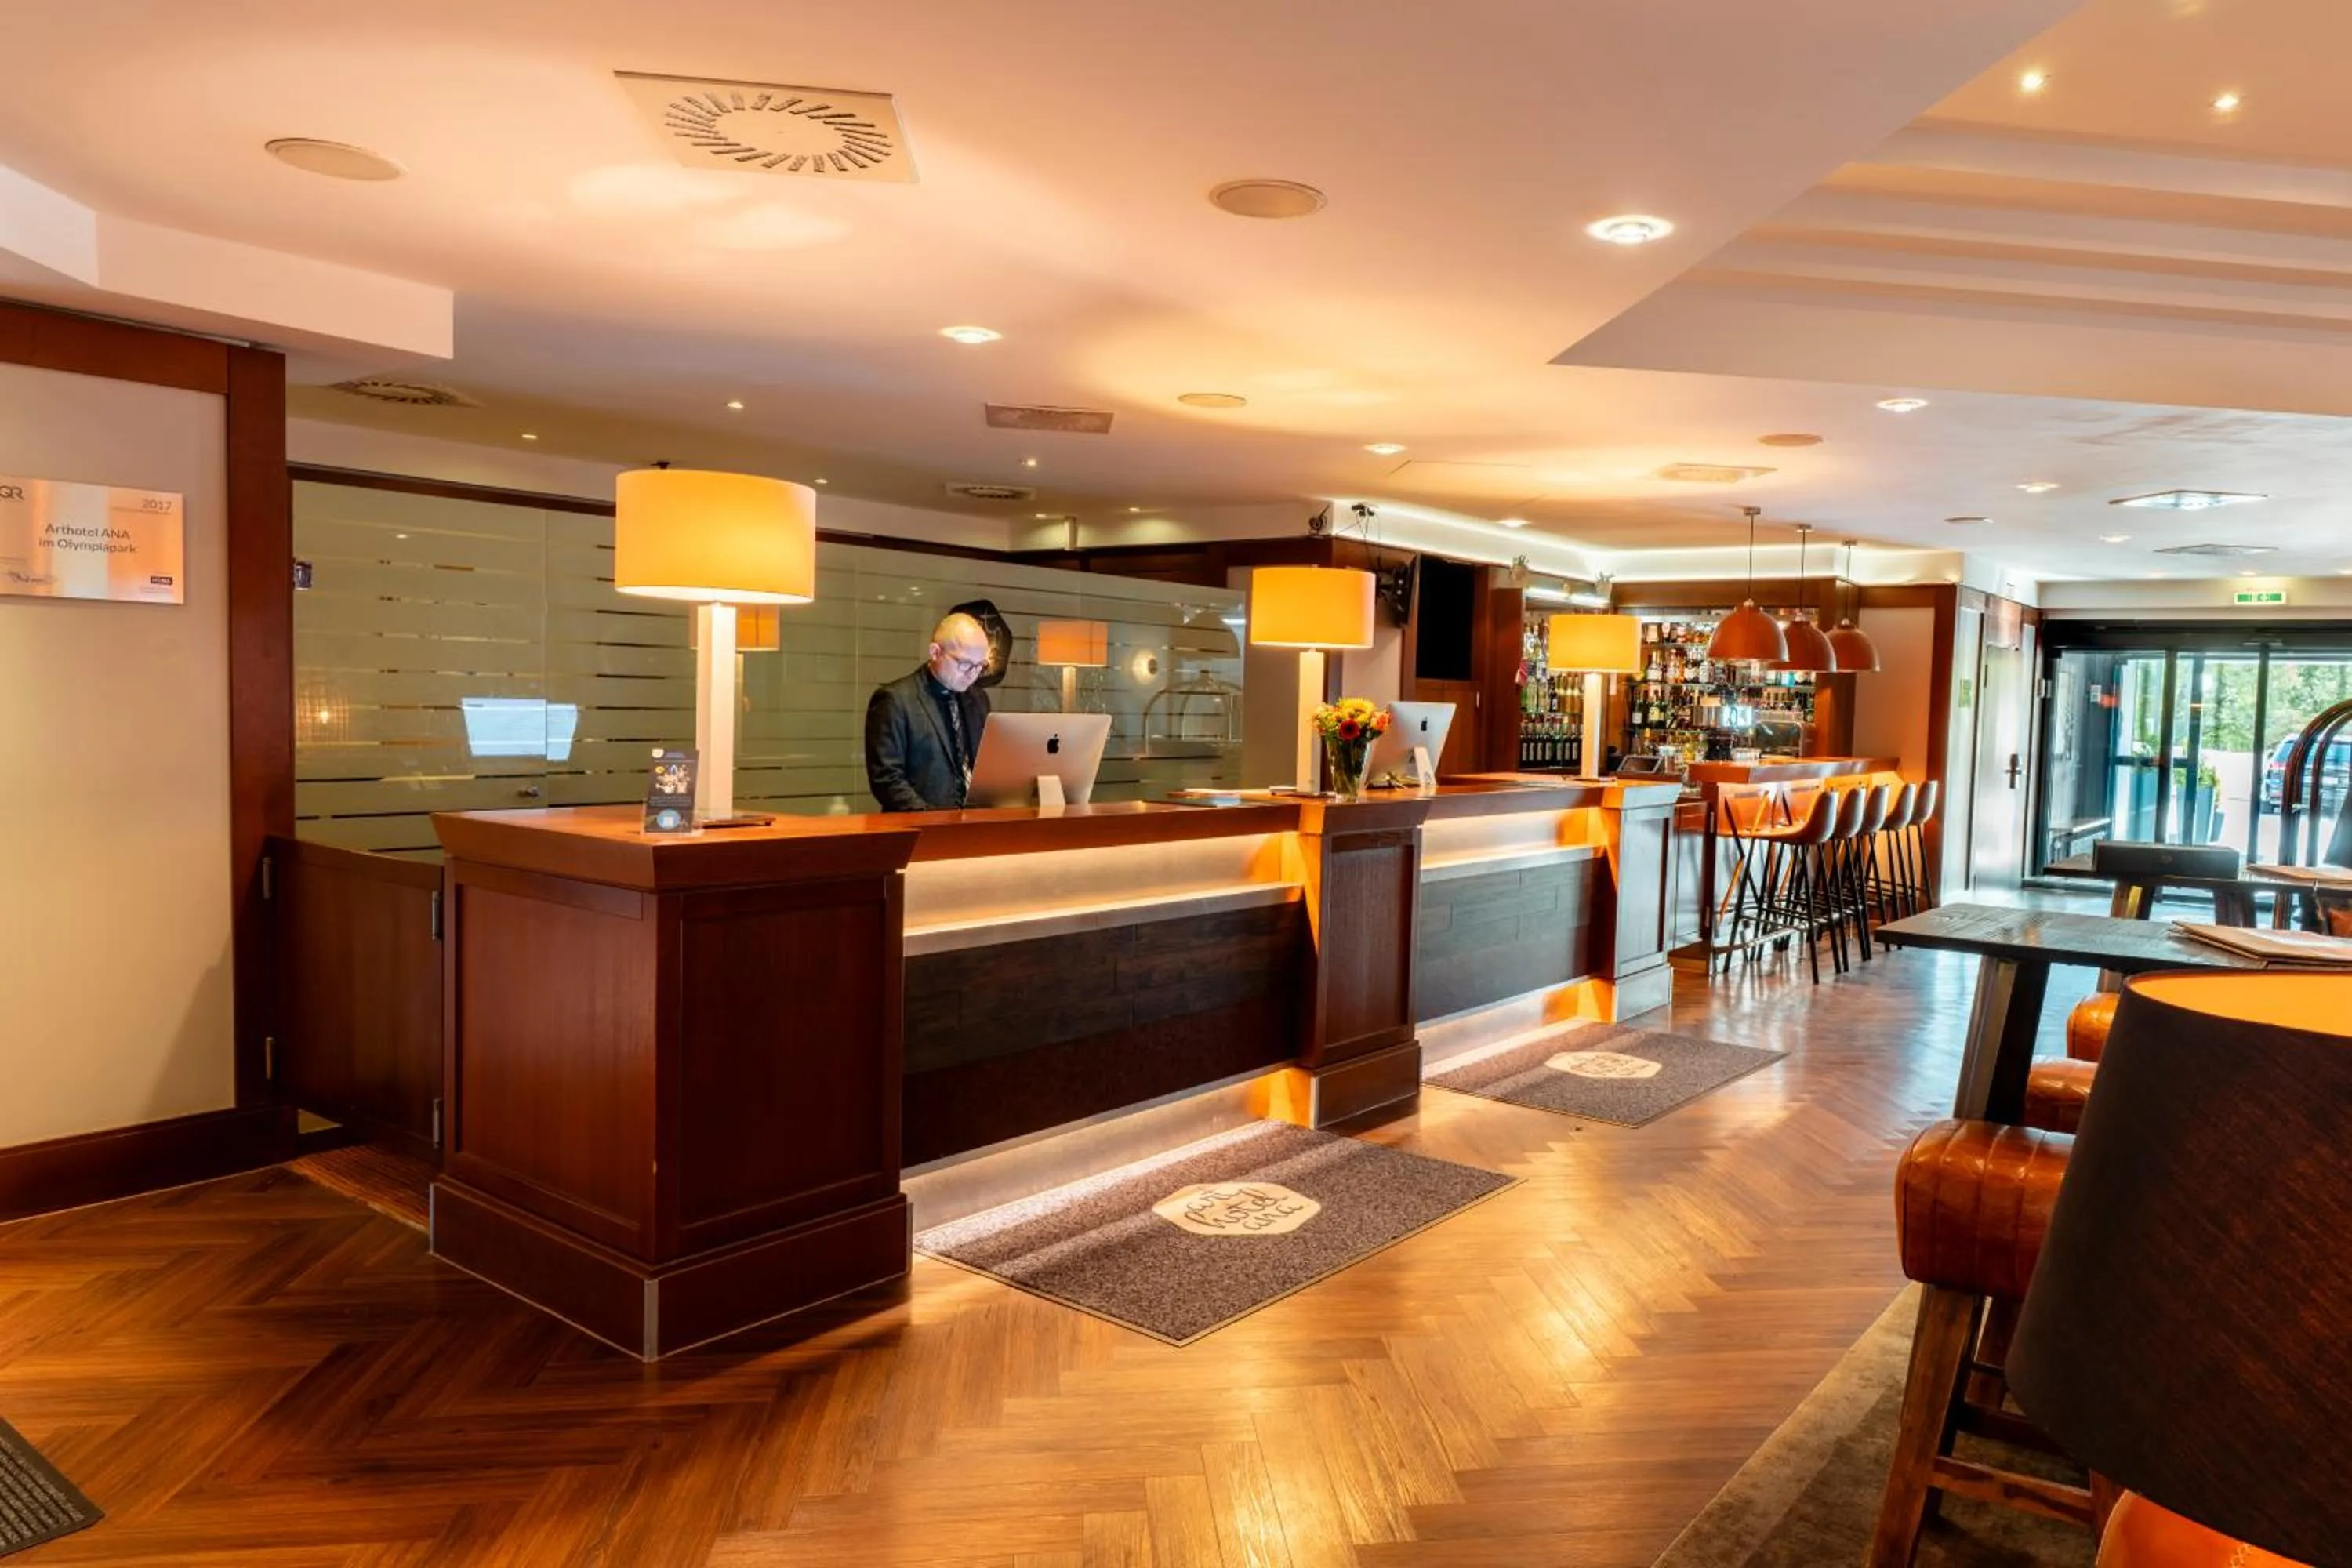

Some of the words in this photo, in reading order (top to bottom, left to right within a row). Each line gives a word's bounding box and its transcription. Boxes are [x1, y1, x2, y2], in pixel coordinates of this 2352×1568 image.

[142, 499, 172, 510] 2017
[45, 524, 98, 538] Arthotel
[102, 528, 131, 540] ANA
[57, 539, 136, 553] Olympiapark
